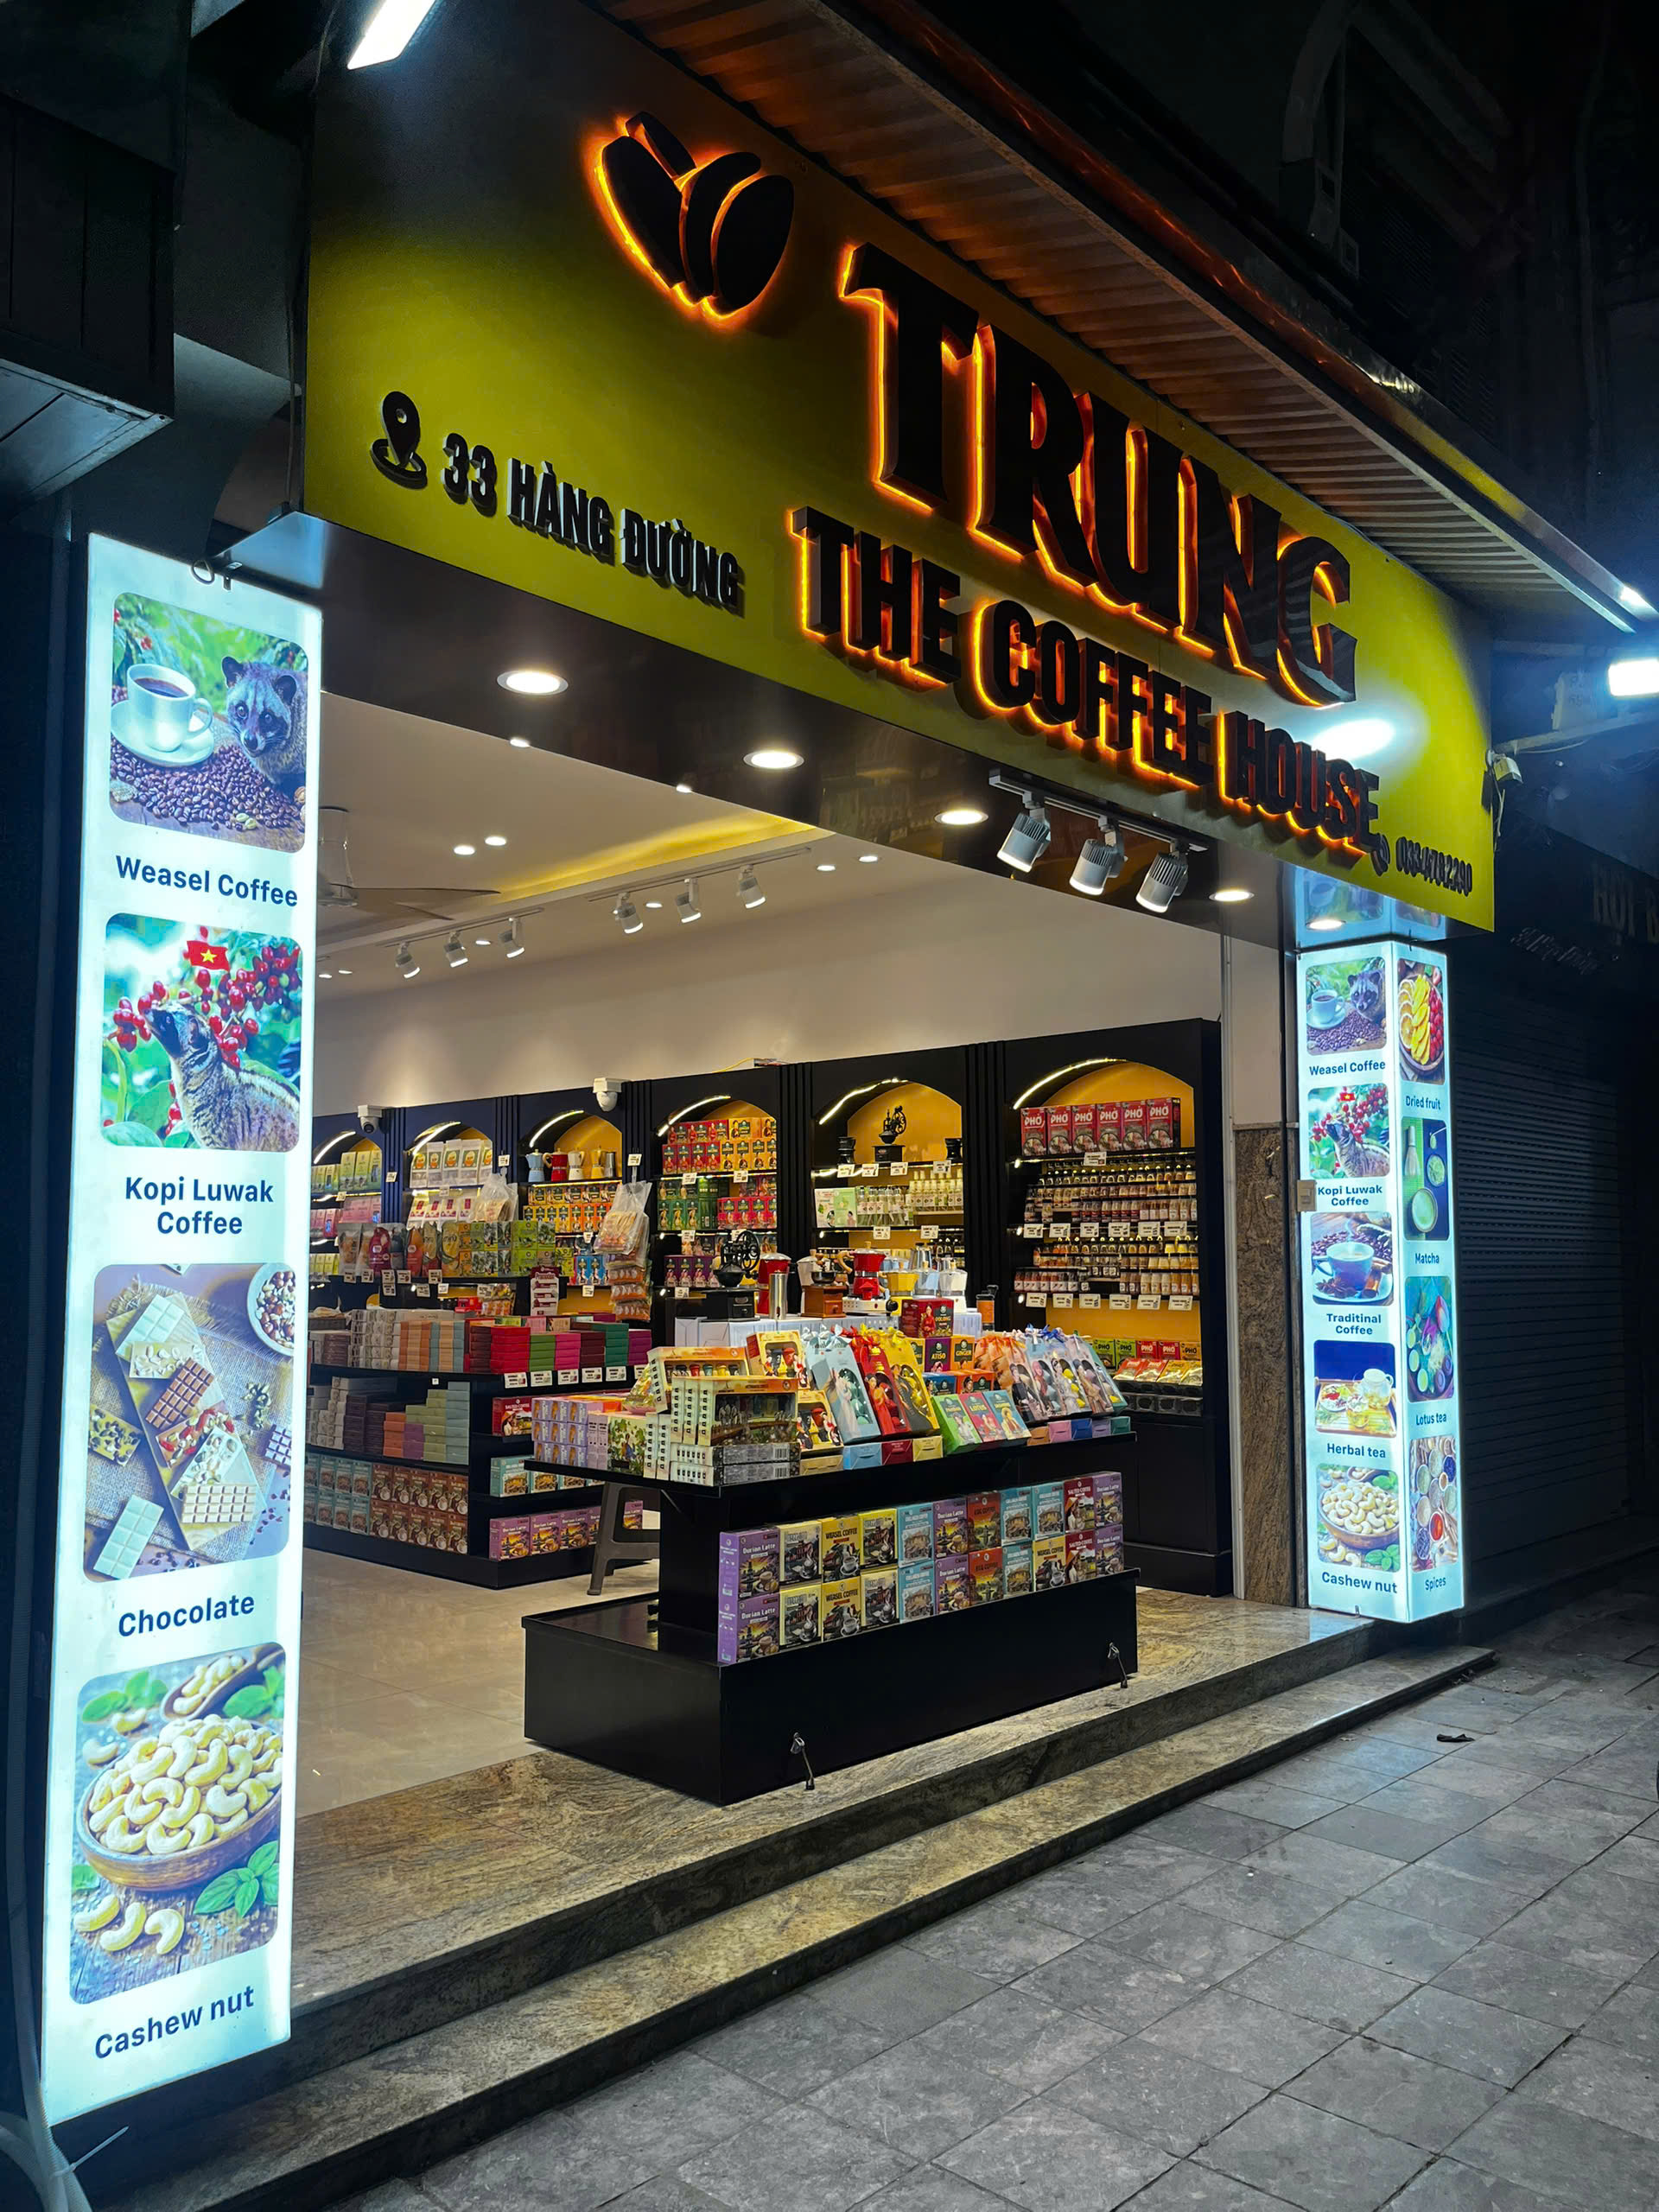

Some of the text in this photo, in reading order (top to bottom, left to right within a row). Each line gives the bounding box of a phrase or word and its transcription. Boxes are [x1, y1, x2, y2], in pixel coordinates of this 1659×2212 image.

[841, 242, 1357, 707] TRUNG
[441, 433, 741, 610] 33 HÀNG ĐƯỜNG
[789, 505, 1380, 855] THE COFFEE HOUSE
[115, 855, 298, 907] Weasel Coffee
[1309, 1060, 1386, 1076] Weasel Coffee
[1405, 1096, 1440, 1110] Dried fruit
[125, 1176, 274, 1205] Kopi Luwak
[1318, 1184, 1382, 1198] Kopi Luwak
[1331, 1196, 1369, 1206] Coffee
[156, 1211, 243, 1235] Coffee
[1414, 1253, 1440, 1264] Matcha
[1326, 1313, 1382, 1324] Traditinal
[1335, 1325, 1373, 1335] Coffee
[1415, 1411, 1447, 1426] Lotus tea
[1326, 1443, 1386, 1459] Herbal tea
[1322, 1571, 1397, 1594] Cashew nut
[1425, 1576, 1446, 1592] Spices
[118, 1594, 255, 1637] Chocolate
[94, 1986, 255, 2060] Cashew nut
